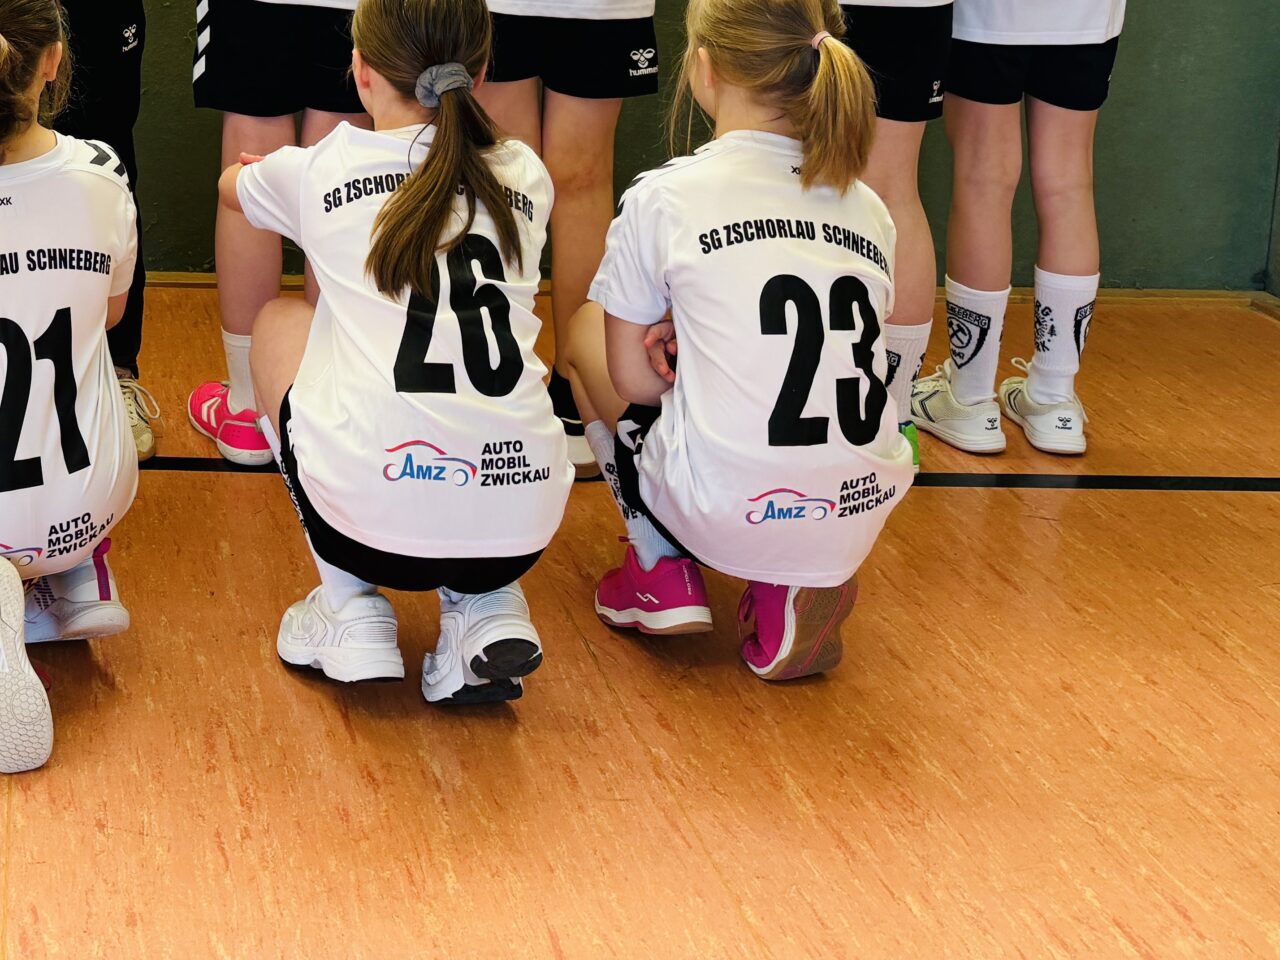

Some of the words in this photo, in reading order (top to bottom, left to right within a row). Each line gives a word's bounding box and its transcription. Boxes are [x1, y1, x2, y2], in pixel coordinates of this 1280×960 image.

[324, 187, 342, 213] SG
[699, 228, 723, 255] SG
[723, 219, 816, 246] ZSCHORLAU
[26, 248, 111, 276] SCHNEEBERG
[393, 233, 524, 398] 26
[759, 274, 888, 446] 23
[481, 440, 523, 455] AUTO
[480, 455, 531, 471] MOBIL
[480, 467, 550, 487] ZWICKAU
[840, 472, 876, 492] AUTO
[837, 485, 896, 518] ZWICKAU
[839, 483, 882, 505] MOBIL
[45, 513, 114, 559] ZWICKAU
[47, 512, 92, 536] AUTO
[47, 521, 98, 548] MOBIL
